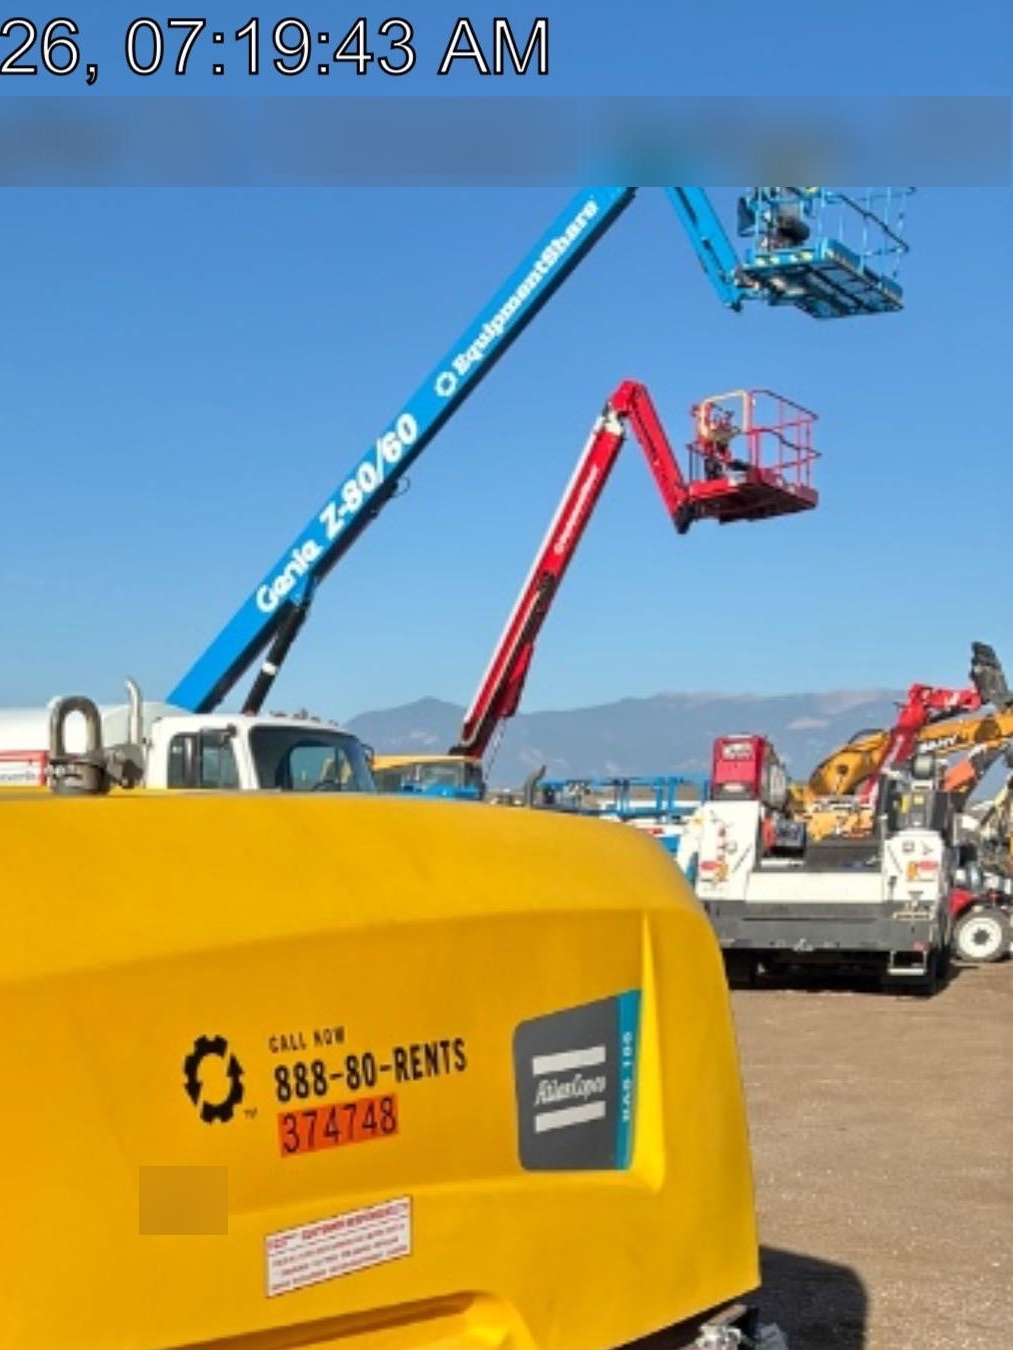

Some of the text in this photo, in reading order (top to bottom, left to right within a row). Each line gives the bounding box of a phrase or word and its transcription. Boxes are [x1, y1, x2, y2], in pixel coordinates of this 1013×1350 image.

[452, 200, 598, 376] EquipmentShare
[256, 413, 418, 613] Genie Z-80/60
[268, 1026, 346, 1054] CALL NOW
[274, 1037, 467, 1103] 888-80-RENTS
[282, 1096, 397, 1154] 374748
